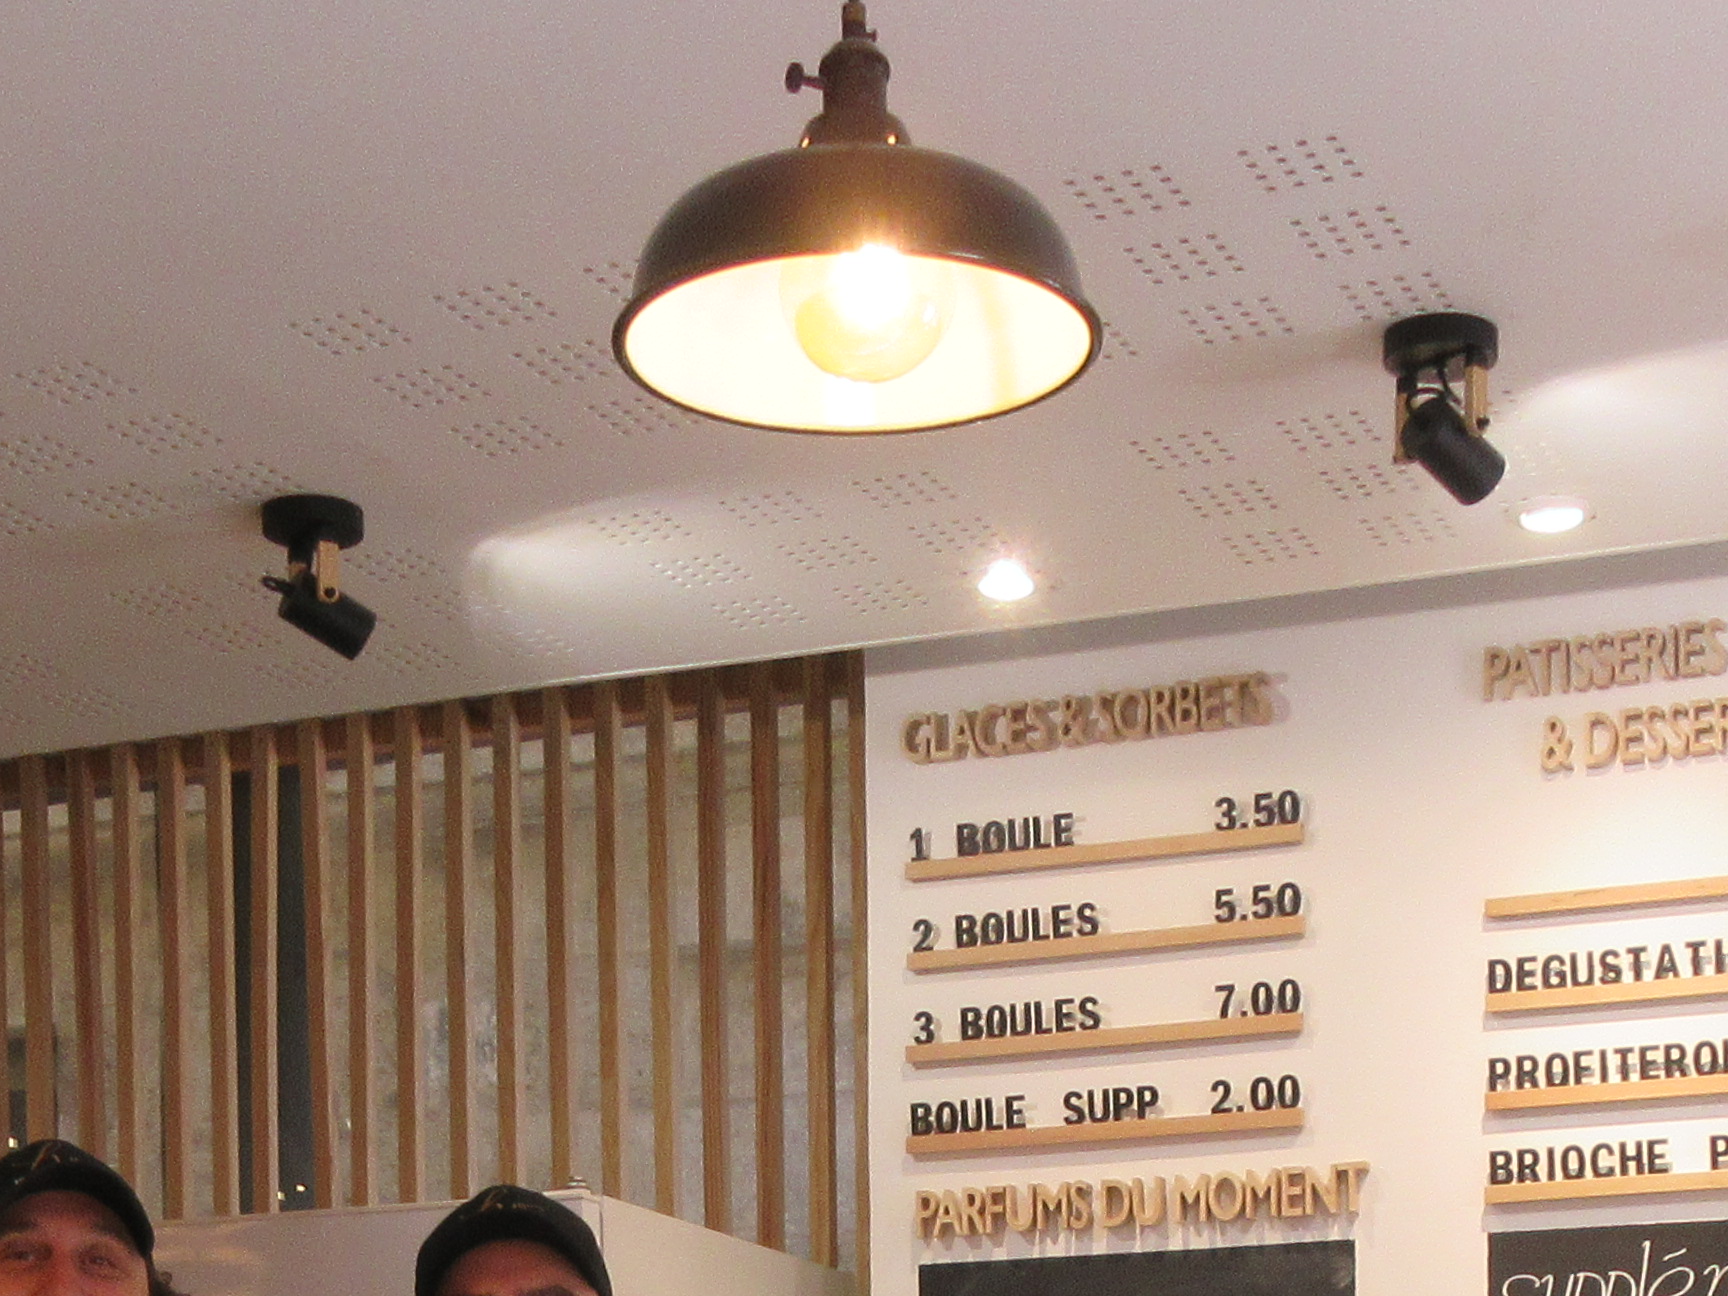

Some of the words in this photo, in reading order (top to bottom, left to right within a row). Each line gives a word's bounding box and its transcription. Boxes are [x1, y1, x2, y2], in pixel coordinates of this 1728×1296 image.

[1540, 716, 1573, 774] &
[908, 828, 929, 861] 1
[956, 813, 1075, 857] BOULE
[1214, 790, 1302, 831] 3.50
[912, 920, 935, 953] 2
[955, 902, 1100, 949] BOULES
[1214, 882, 1303, 922] 5.50
[914, 1012, 936, 1045] 3
[960, 997, 1102, 1041] BOULES
[1215, 979, 1303, 1020] 7.00
[909, 1096, 1027, 1136] BOULE
[1063, 1085, 1160, 1125] SUPP
[1210, 1074, 1302, 1115] 2.00
[1488, 1139, 1669, 1186] BRIOCHE
[915, 1180, 1093, 1240] PARFUMS
[1100, 1176, 1167, 1229] DU
[1173, 1161, 1370, 1224] MOMENT
